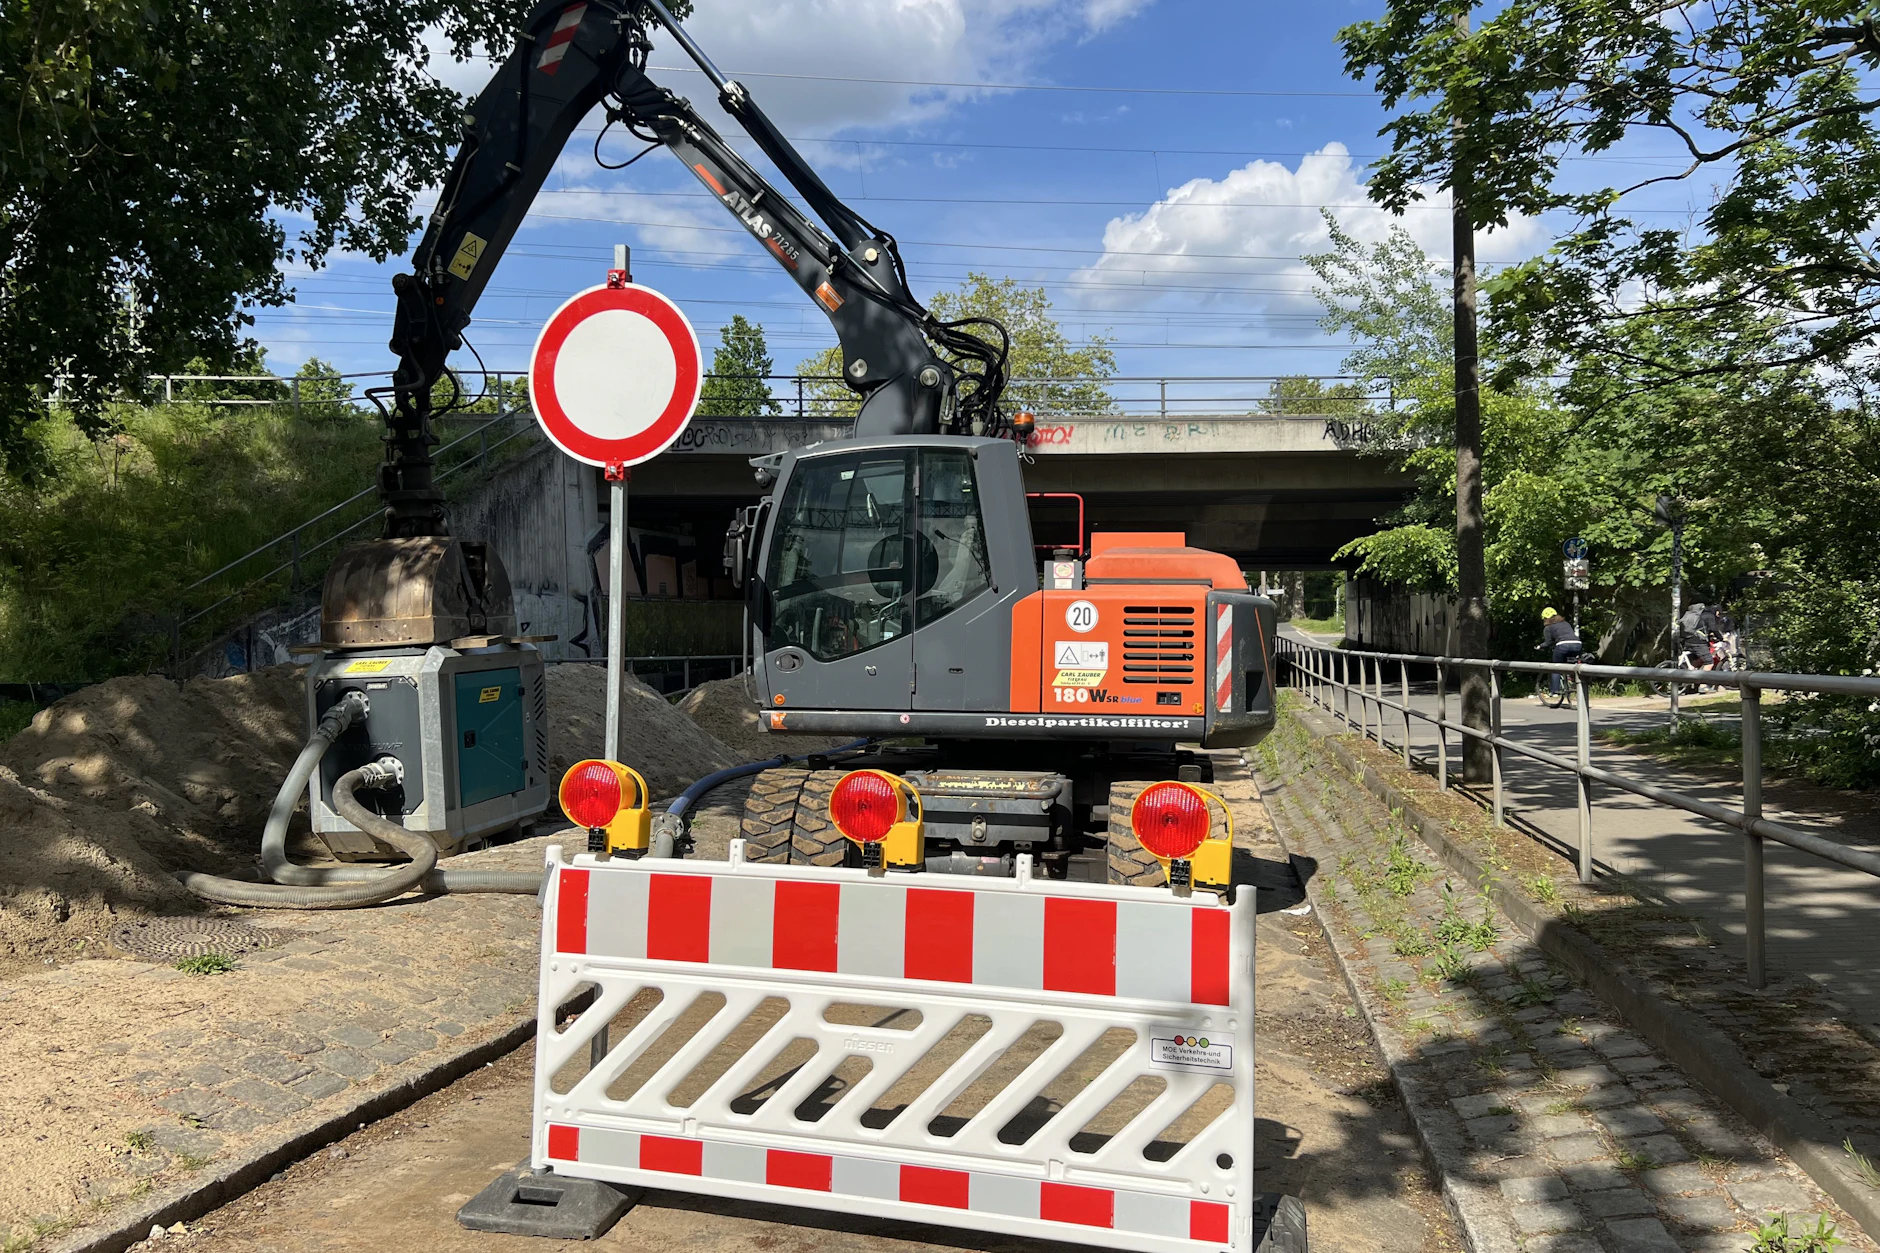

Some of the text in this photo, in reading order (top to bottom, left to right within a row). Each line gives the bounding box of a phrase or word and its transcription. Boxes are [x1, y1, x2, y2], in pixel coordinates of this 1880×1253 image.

[722, 191, 773, 239] ATLAS
[1073, 606, 1092, 626] 20
[1120, 694, 1143, 703] blue
[985, 717, 1190, 729] Dieselpartikelfilter!
[843, 1032, 895, 1054] nissen
[1162, 1045, 1221, 1057] MOE Verkehrs-und
[1162, 1053, 1221, 1065] Sicherheitstechnik
